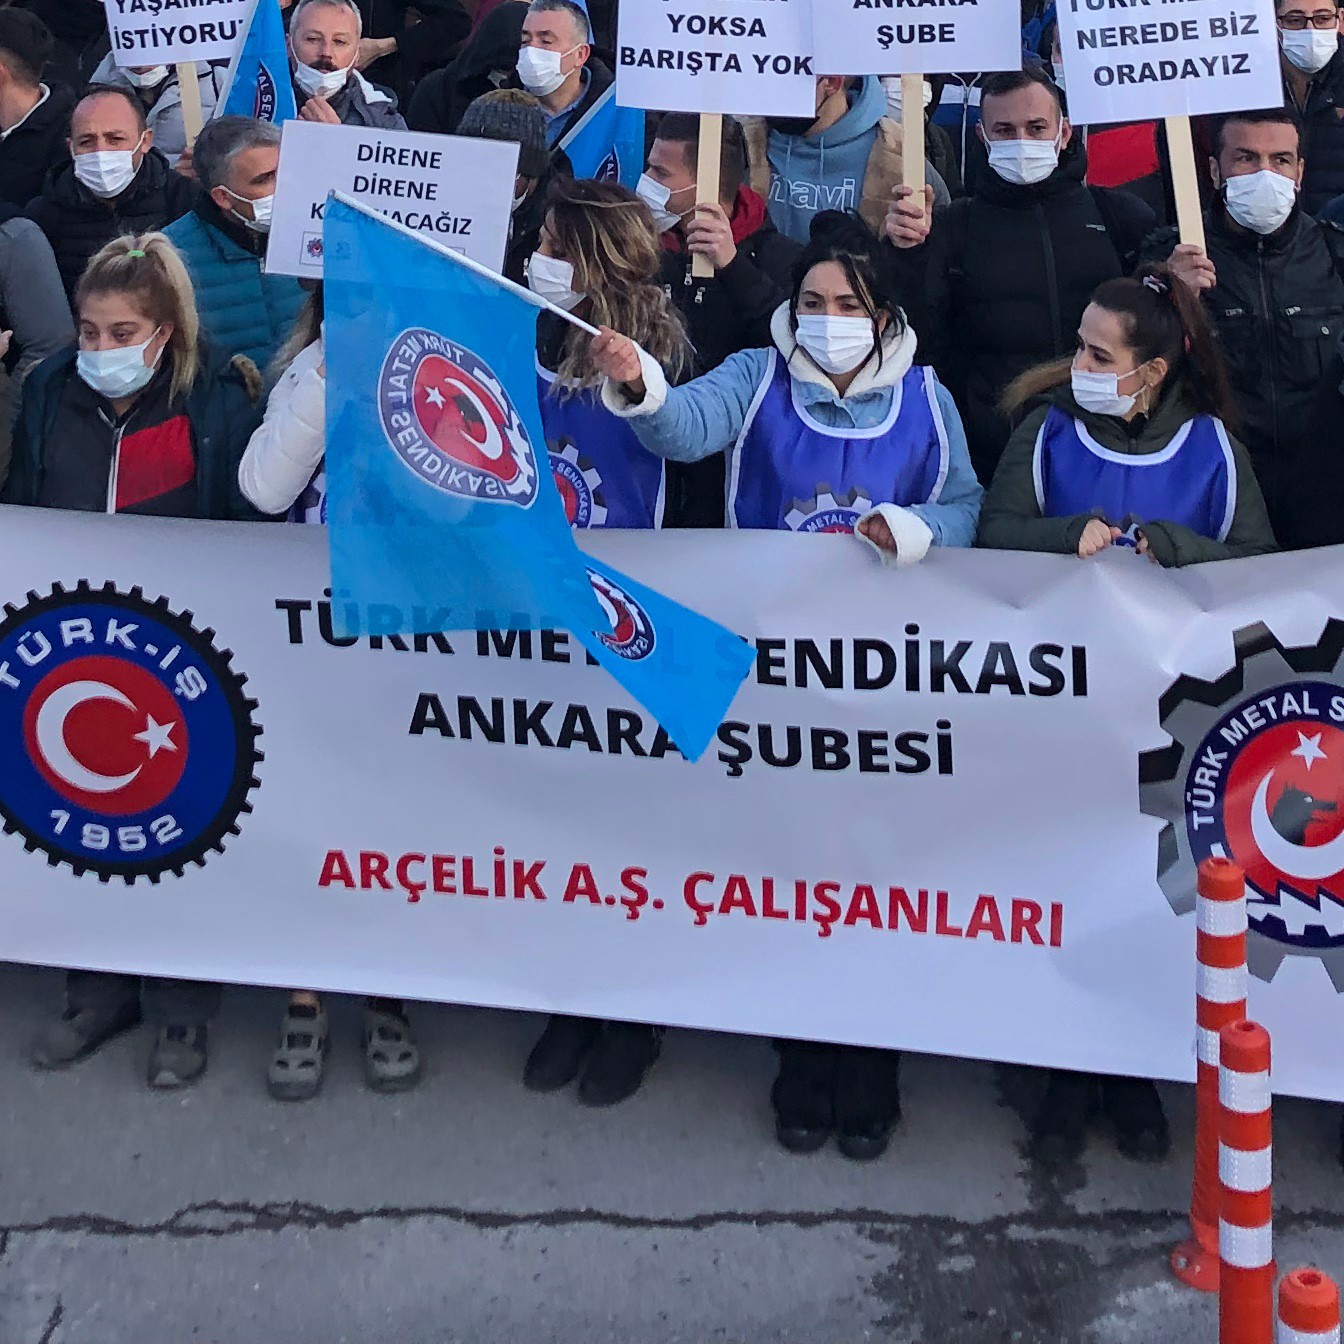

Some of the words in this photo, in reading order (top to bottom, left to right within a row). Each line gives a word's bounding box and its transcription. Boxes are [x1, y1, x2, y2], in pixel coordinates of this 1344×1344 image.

[114, 19, 244, 50] İSTİYORU
[667, 13, 767, 38] YOKSA
[876, 23, 956, 50] ŞUBE
[1076, 19, 1199, 50] NEREDE
[1209, 11, 1259, 38] BİZ
[620, 46, 742, 76] BARIŞTA
[752, 54, 813, 75] YOK
[1093, 53, 1251, 87] ORADAYIZ
[357, 141, 443, 170] DİRENE
[353, 172, 438, 201] DİRENE
[275, 587, 456, 655] TÜRK
[716, 718, 954, 777] ŞUBESİ
[1186, 745, 1228, 831] TÜRK
[1219, 690, 1320, 746] METAL
[49, 809, 184, 852] 1952
[317, 845, 548, 903] ARÇELİK
[562, 862, 665, 921] A.Ş.
[683, 870, 1063, 948] ÇALIŞANLARI
